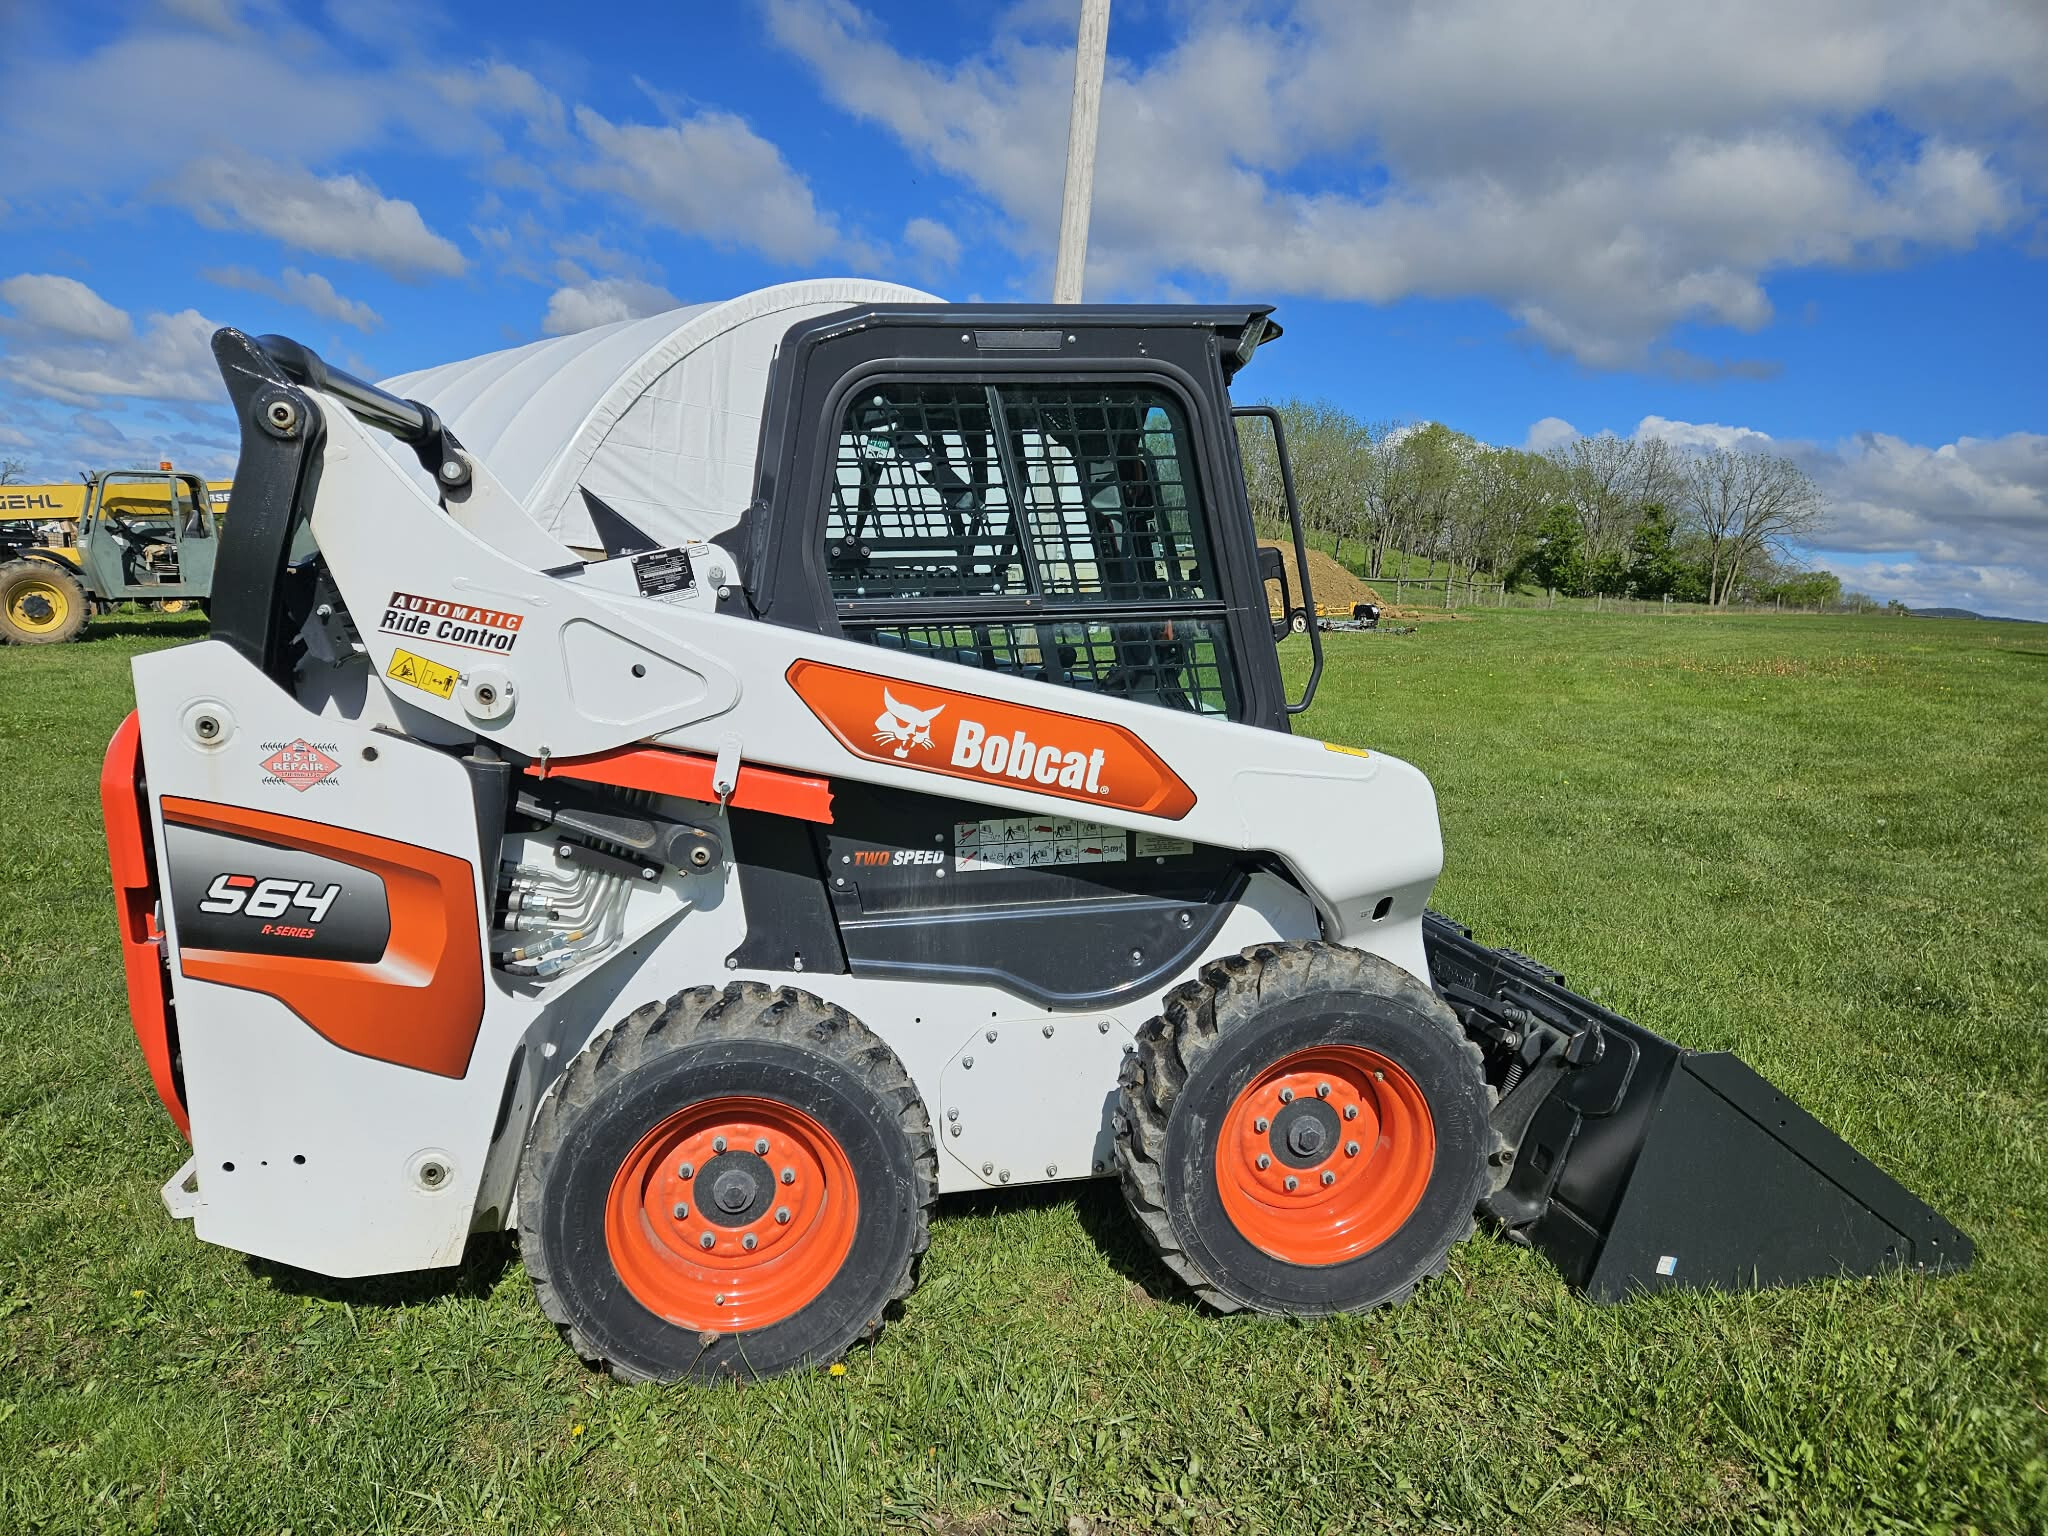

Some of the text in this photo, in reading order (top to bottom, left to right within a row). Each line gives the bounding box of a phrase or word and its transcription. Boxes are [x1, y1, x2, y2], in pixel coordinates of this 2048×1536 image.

[393, 595, 518, 629] AUTOMATIC
[380, 609, 517, 651] Ride Control
[272, 762, 324, 771] REPAIR
[951, 719, 1105, 794] Bobcat
[854, 850, 945, 866] TWO SPEED
[199, 873, 342, 924] S64
[261, 924, 317, 939] R-SERIES
